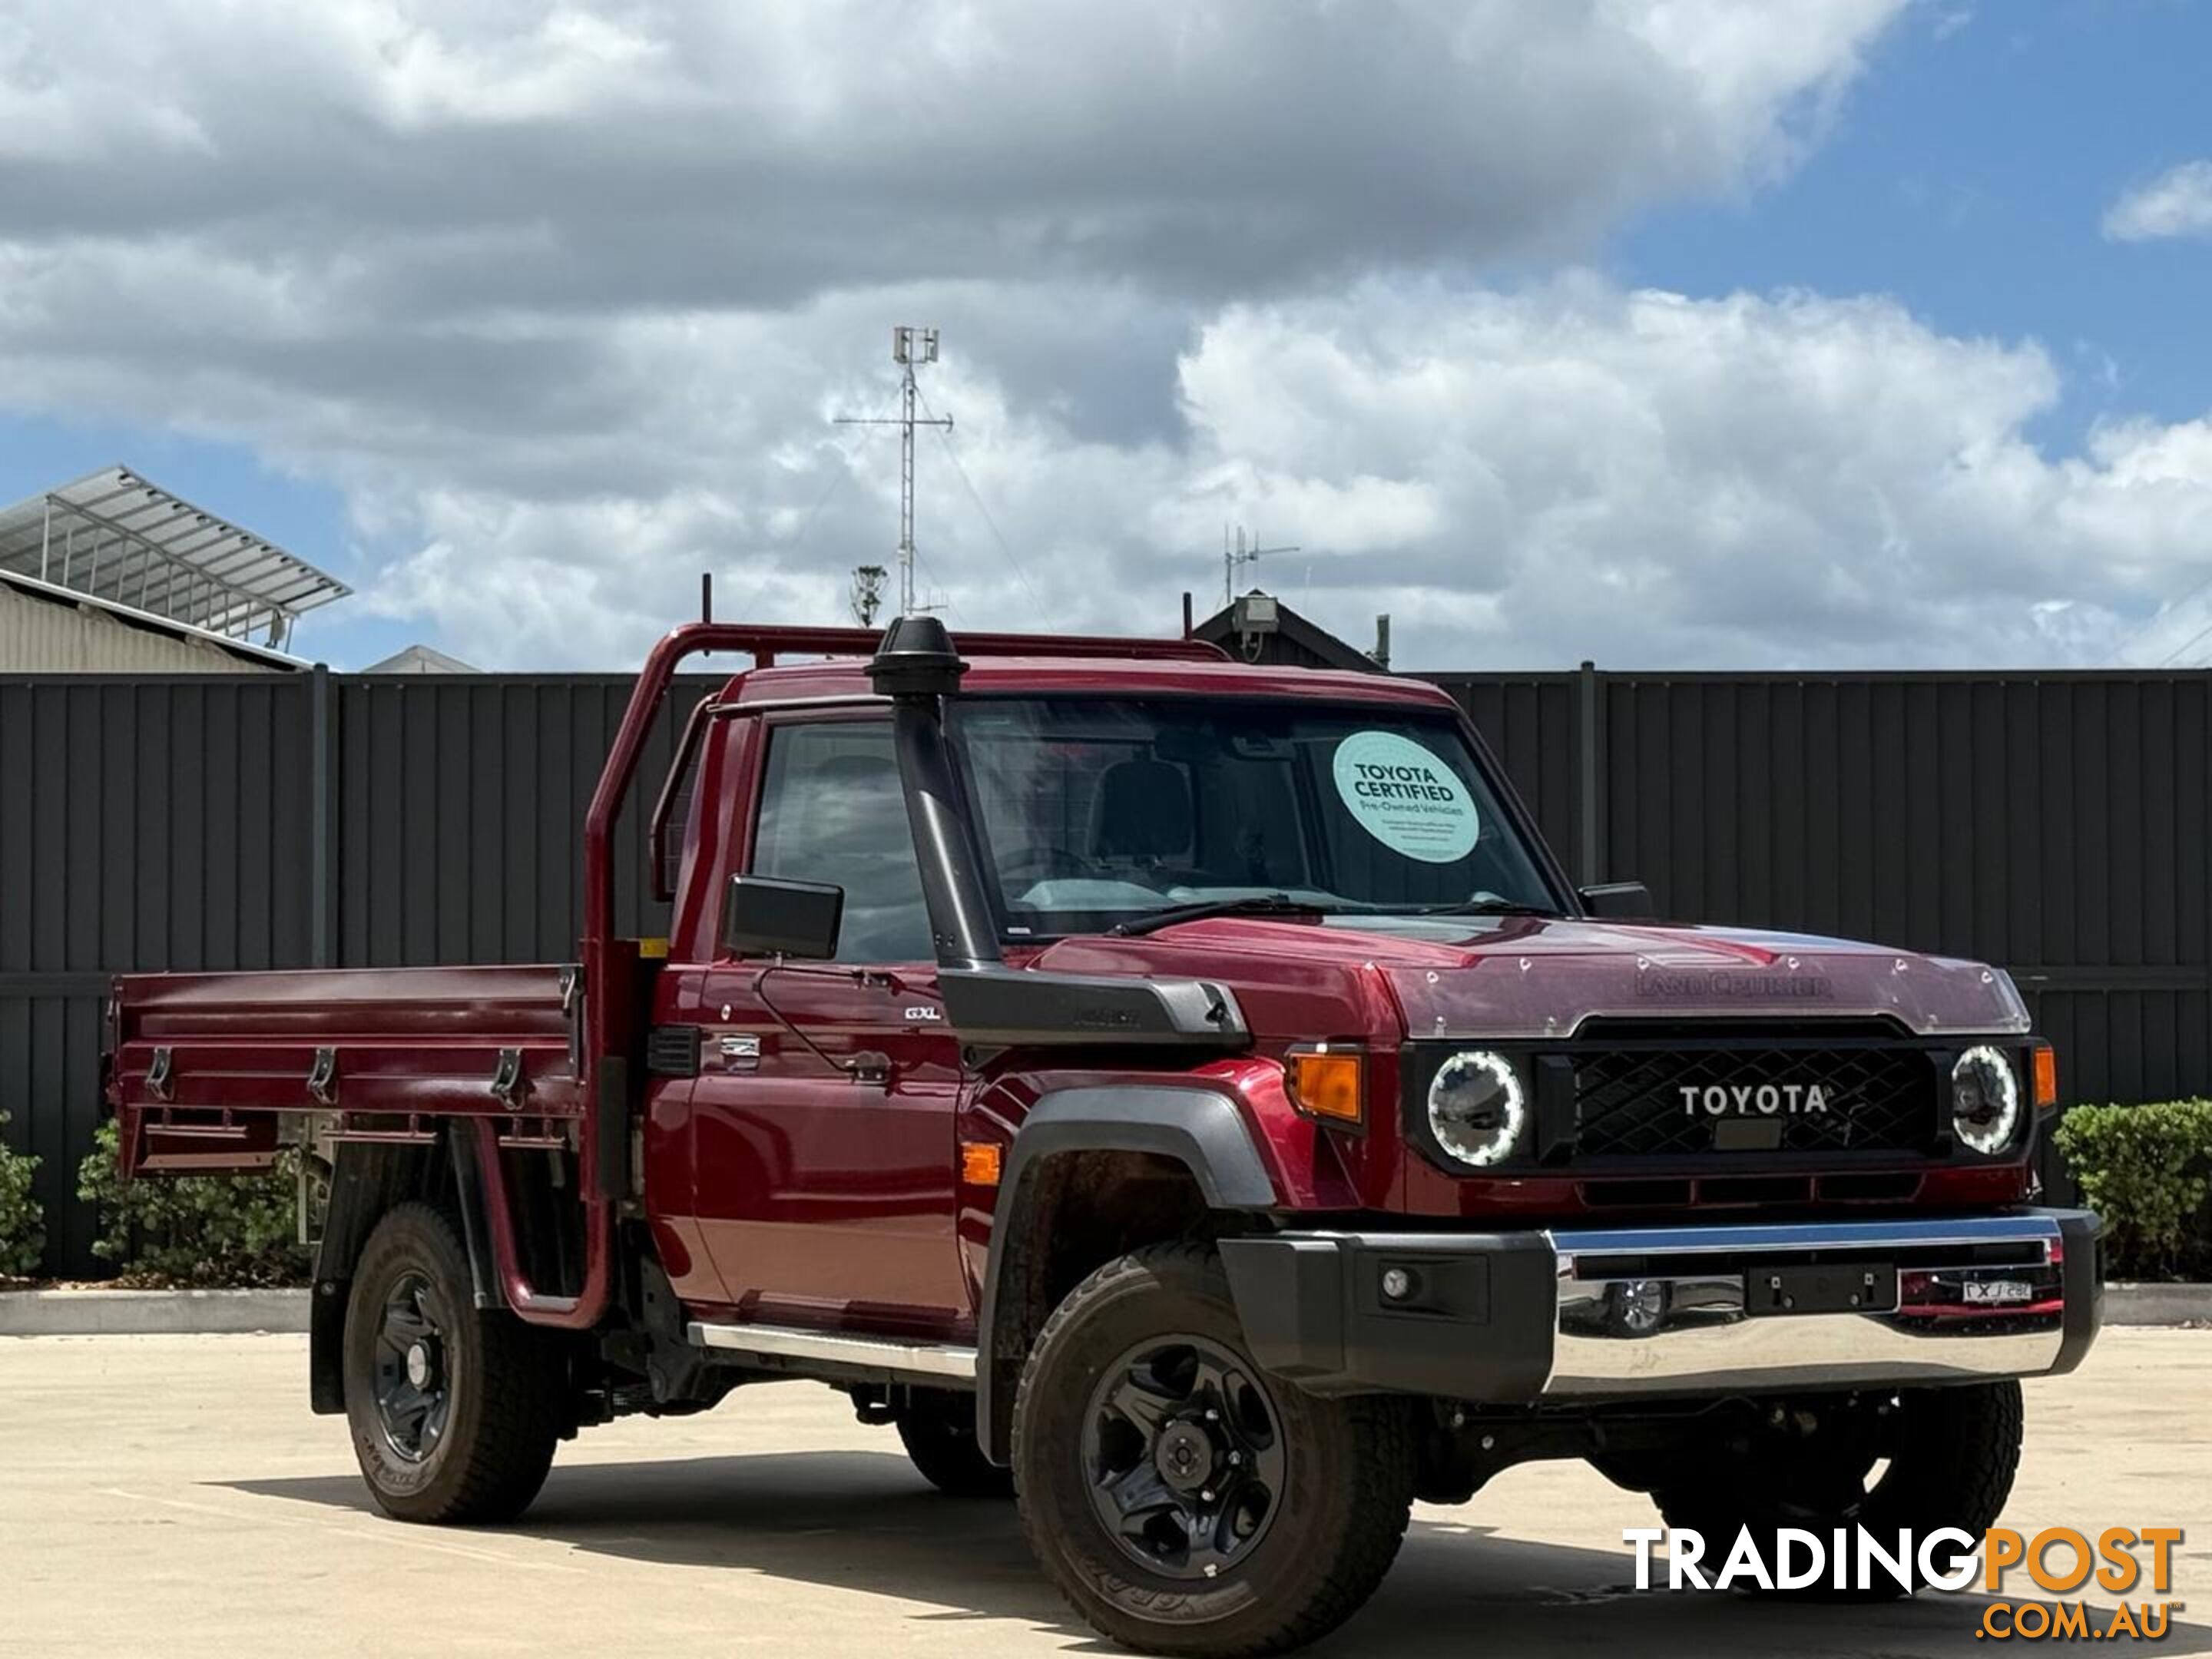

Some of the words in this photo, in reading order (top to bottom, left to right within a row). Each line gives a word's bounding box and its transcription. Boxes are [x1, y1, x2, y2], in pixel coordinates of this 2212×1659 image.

[1354, 764, 1438, 784] TOYOTA
[1354, 781, 1454, 802] CERTIFIED
[906, 1007, 940, 1019] GXL
[1679, 1084, 1828, 1115] TOYOTA
